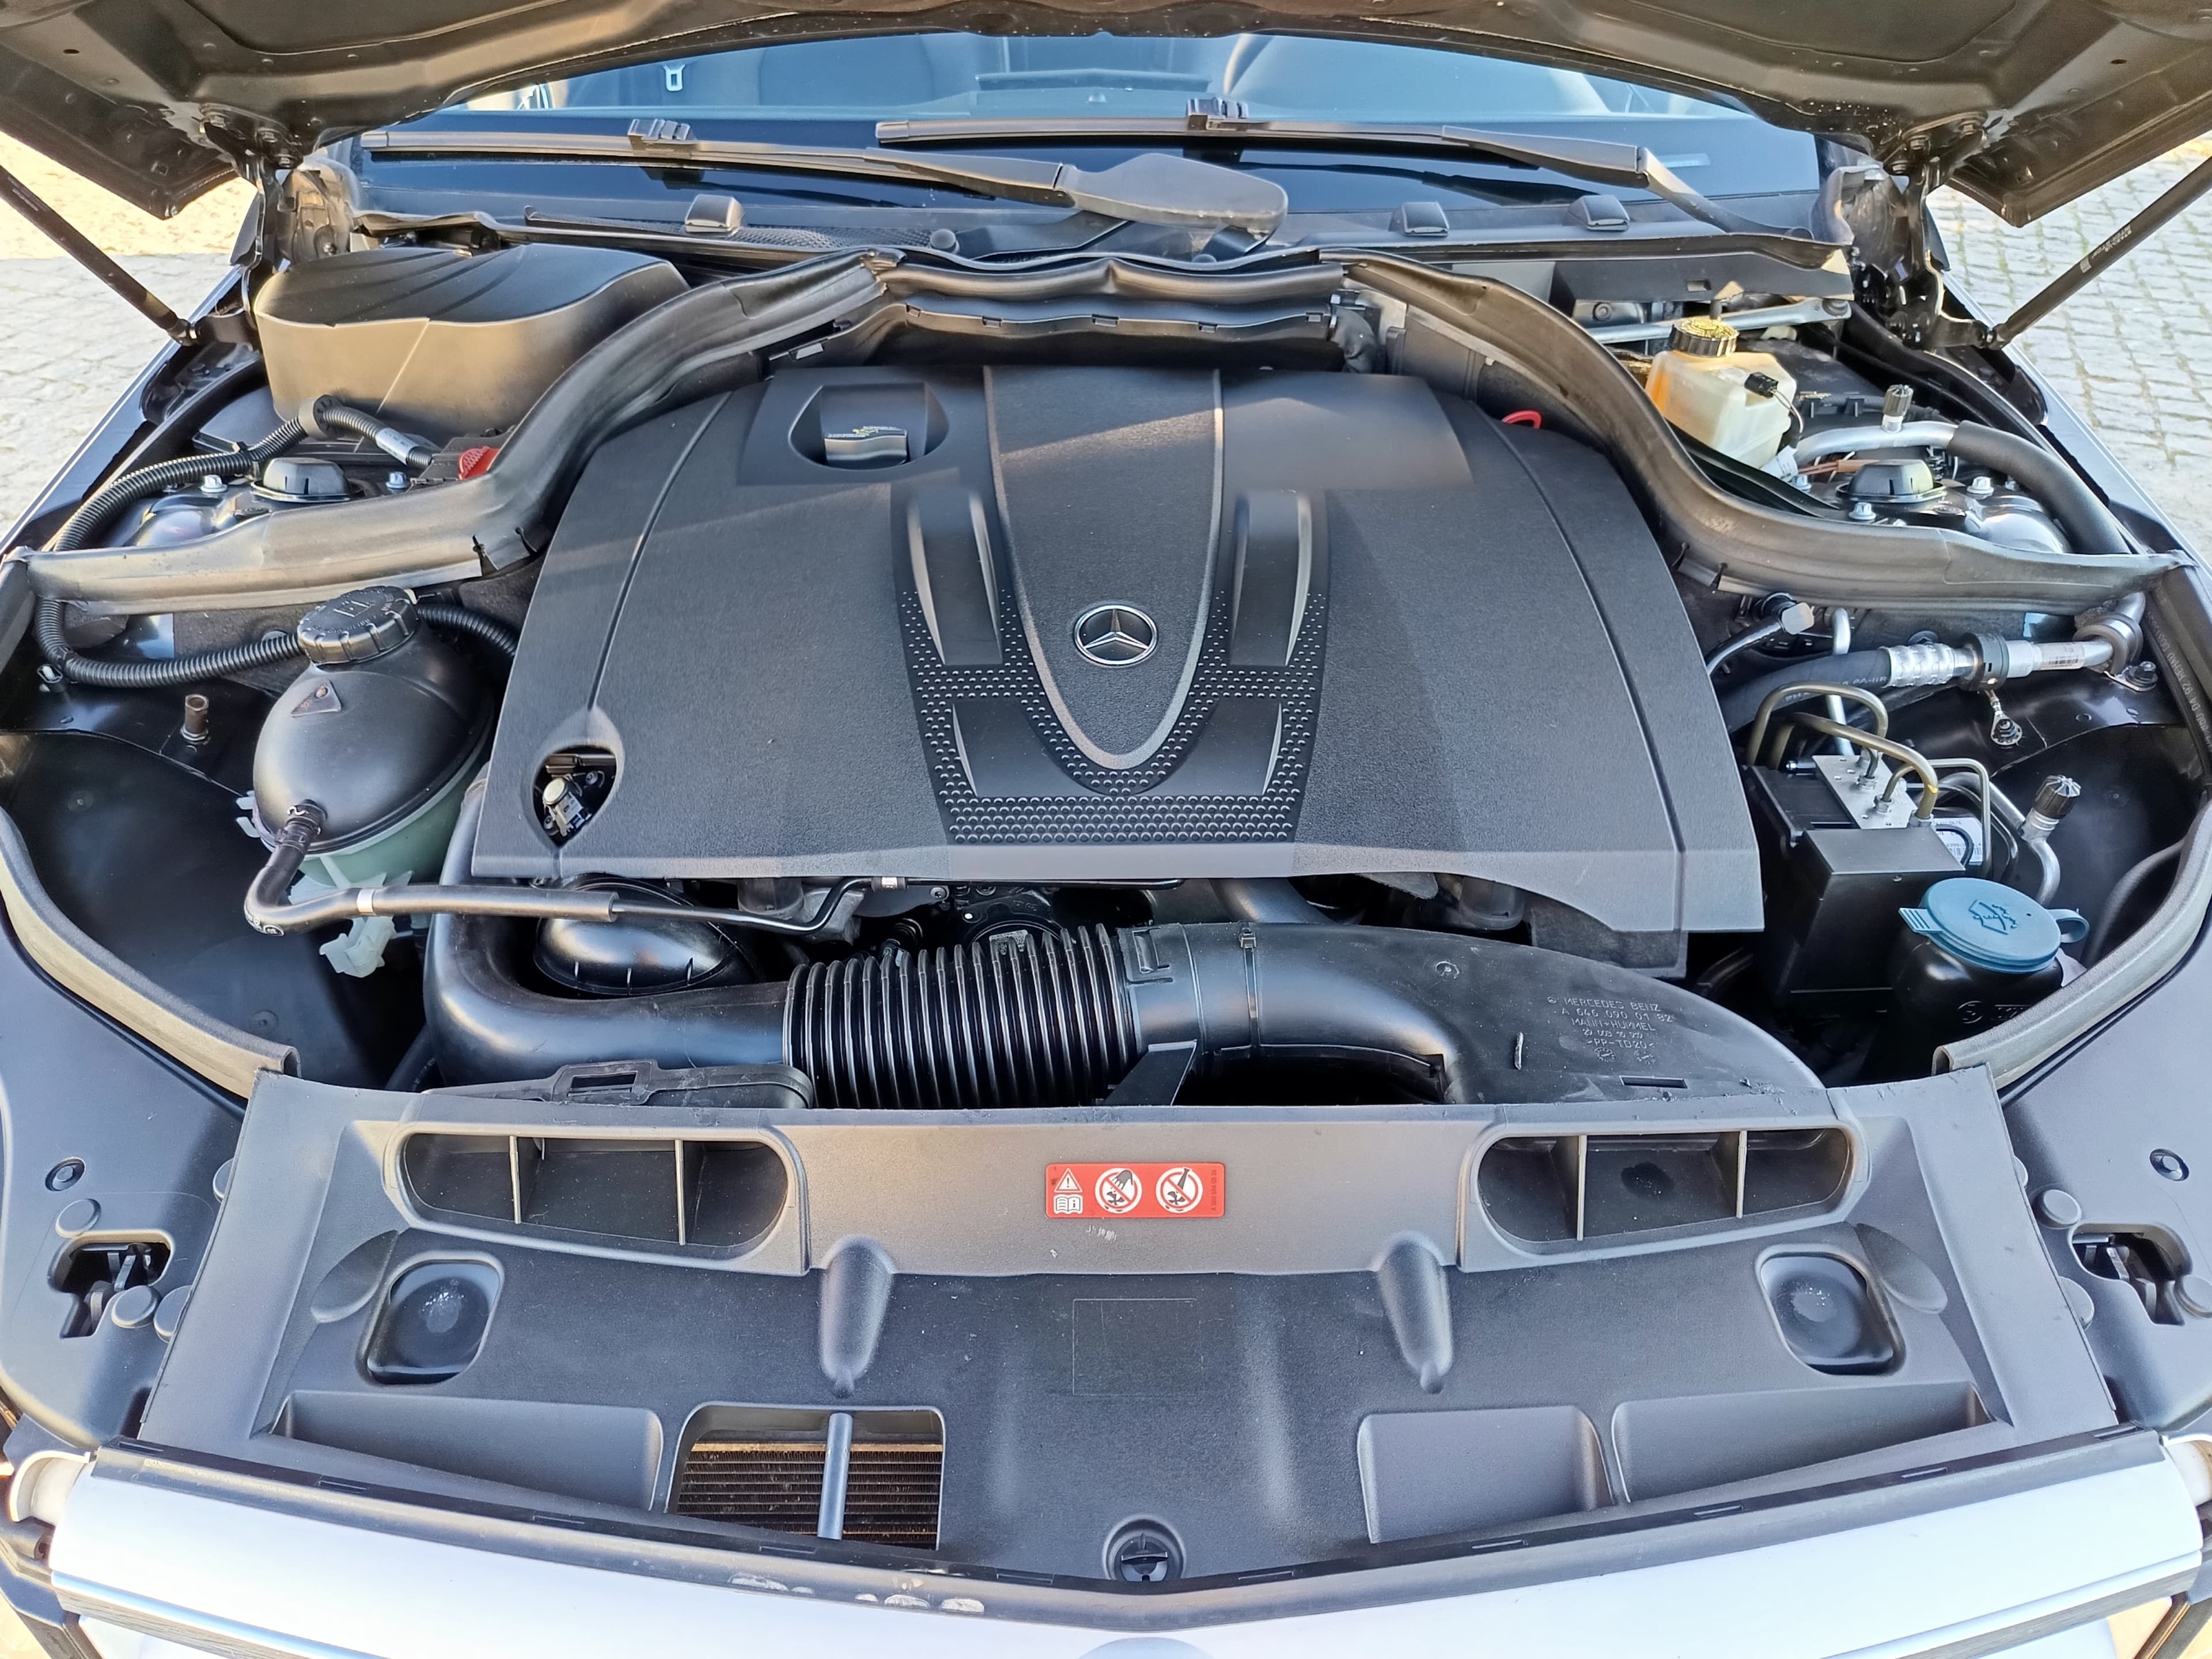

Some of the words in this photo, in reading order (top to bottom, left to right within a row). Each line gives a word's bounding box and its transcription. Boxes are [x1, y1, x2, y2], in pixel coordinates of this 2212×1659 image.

[1563, 997, 1624, 1010] MERCEDES
[1630, 1002, 1661, 1012] BENZ
[1561, 1006, 1570, 1016] A
[1576, 1007, 1599, 1017] 646
[1605, 1009, 1628, 1019] 090
[1635, 1012, 1650, 1021] 01
[1571, 1017, 1656, 1031] MANN+HUMMEL
